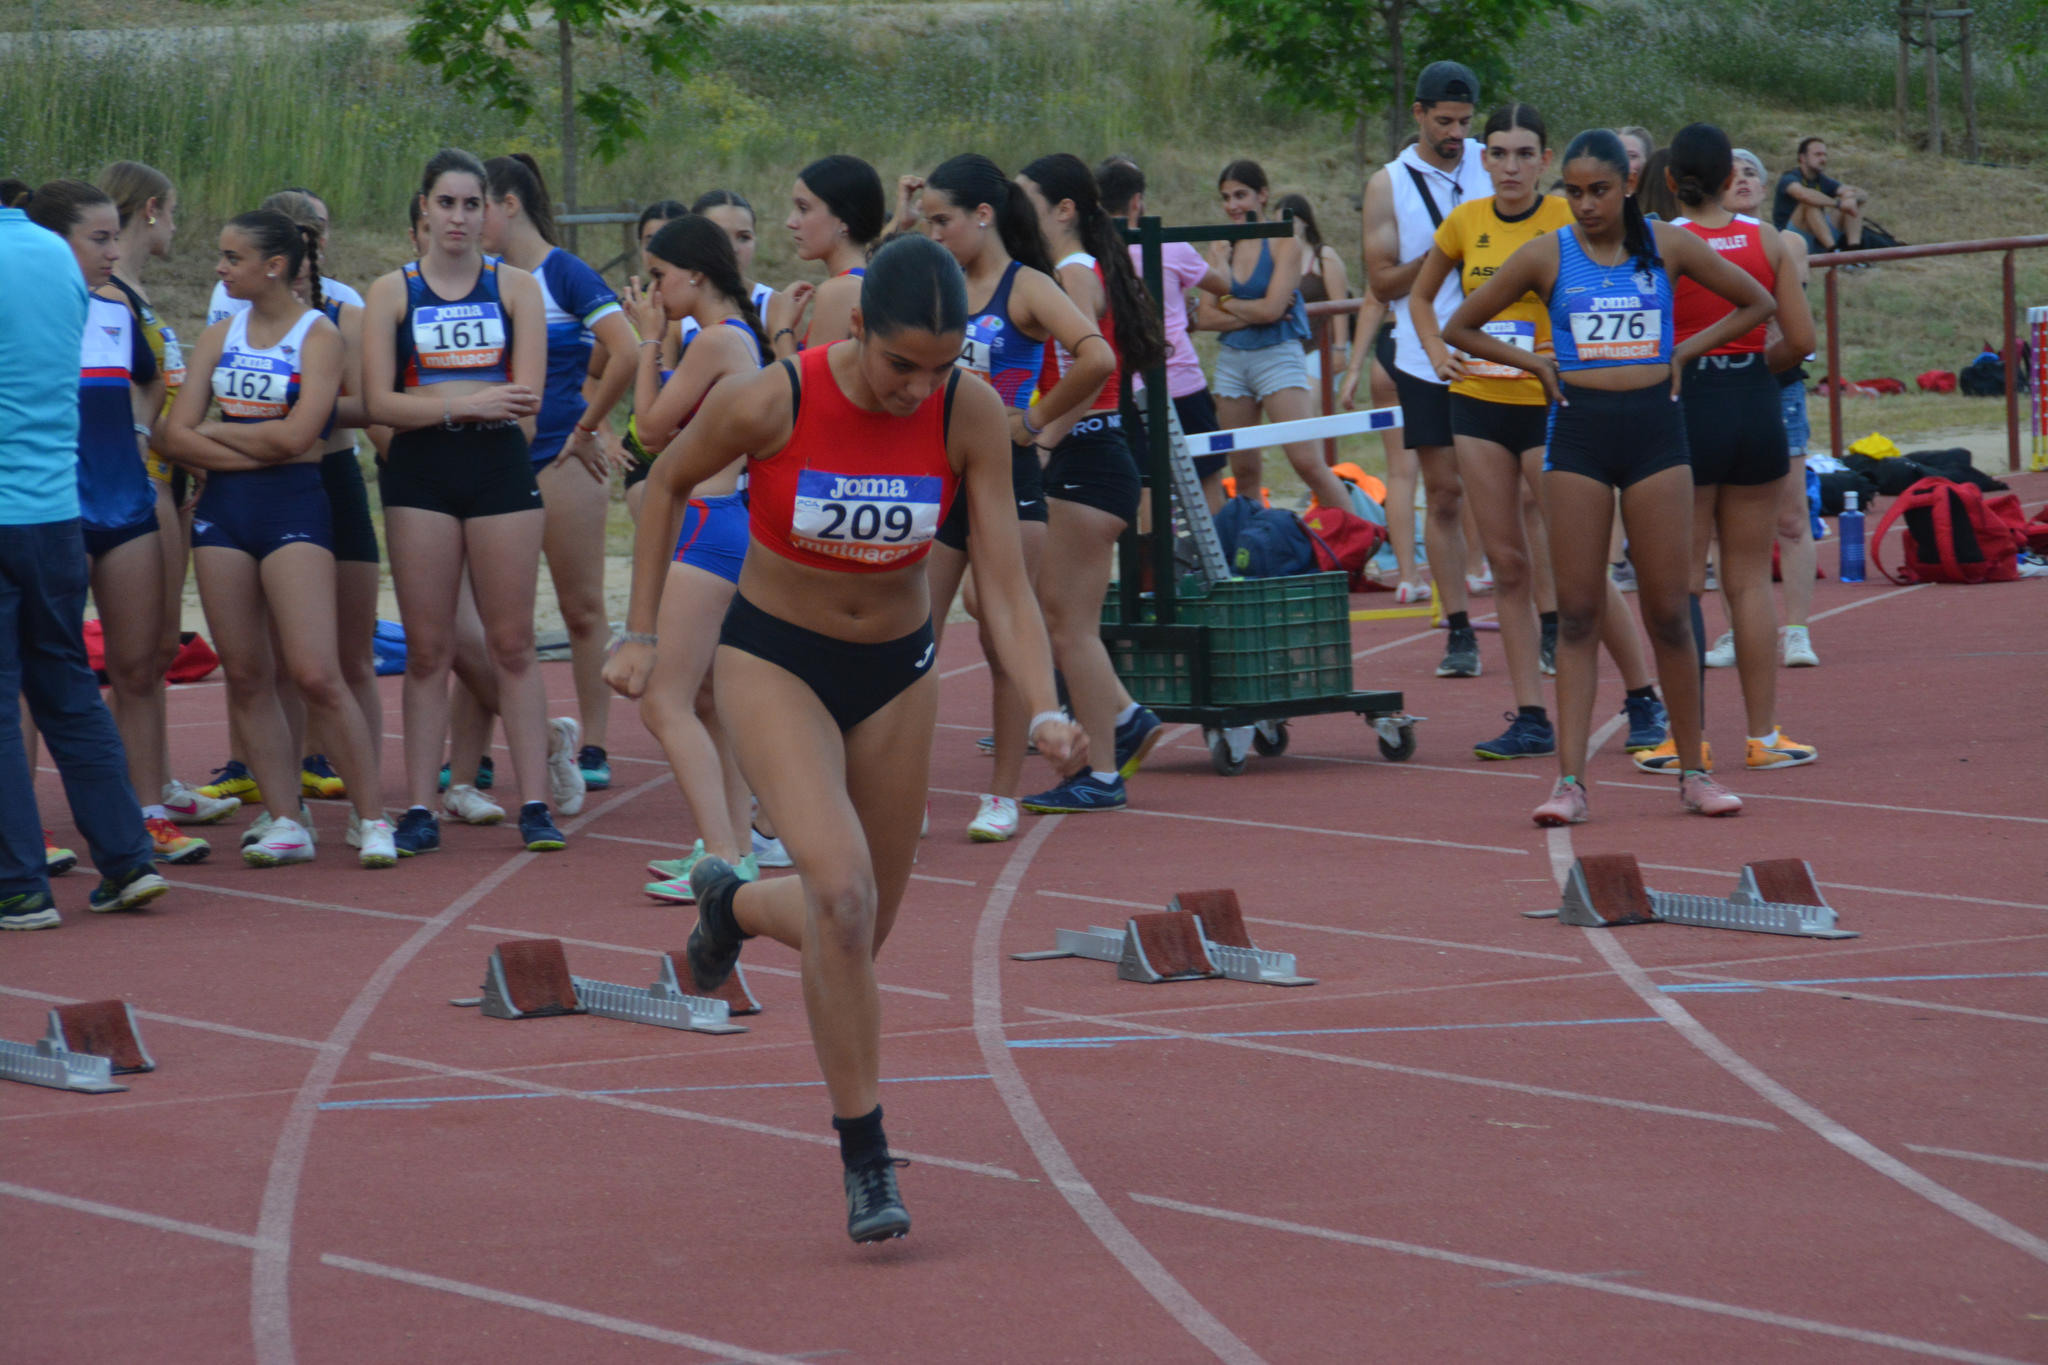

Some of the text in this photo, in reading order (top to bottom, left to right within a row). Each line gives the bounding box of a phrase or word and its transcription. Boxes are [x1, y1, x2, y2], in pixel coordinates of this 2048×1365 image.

[1590, 296, 1642, 311] Joma
[433, 305, 483, 321] Joma
[432, 321, 489, 350] 161
[1483, 322, 1517, 334] oma
[1587, 313, 1646, 341] 276
[424, 350, 500, 367] mutuacat
[1580, 342, 1656, 360] mutuacat
[229, 354, 273, 370] Joma
[224, 370, 272, 401] 162
[829, 477, 909, 498] Joma
[816, 503, 913, 543] 209
